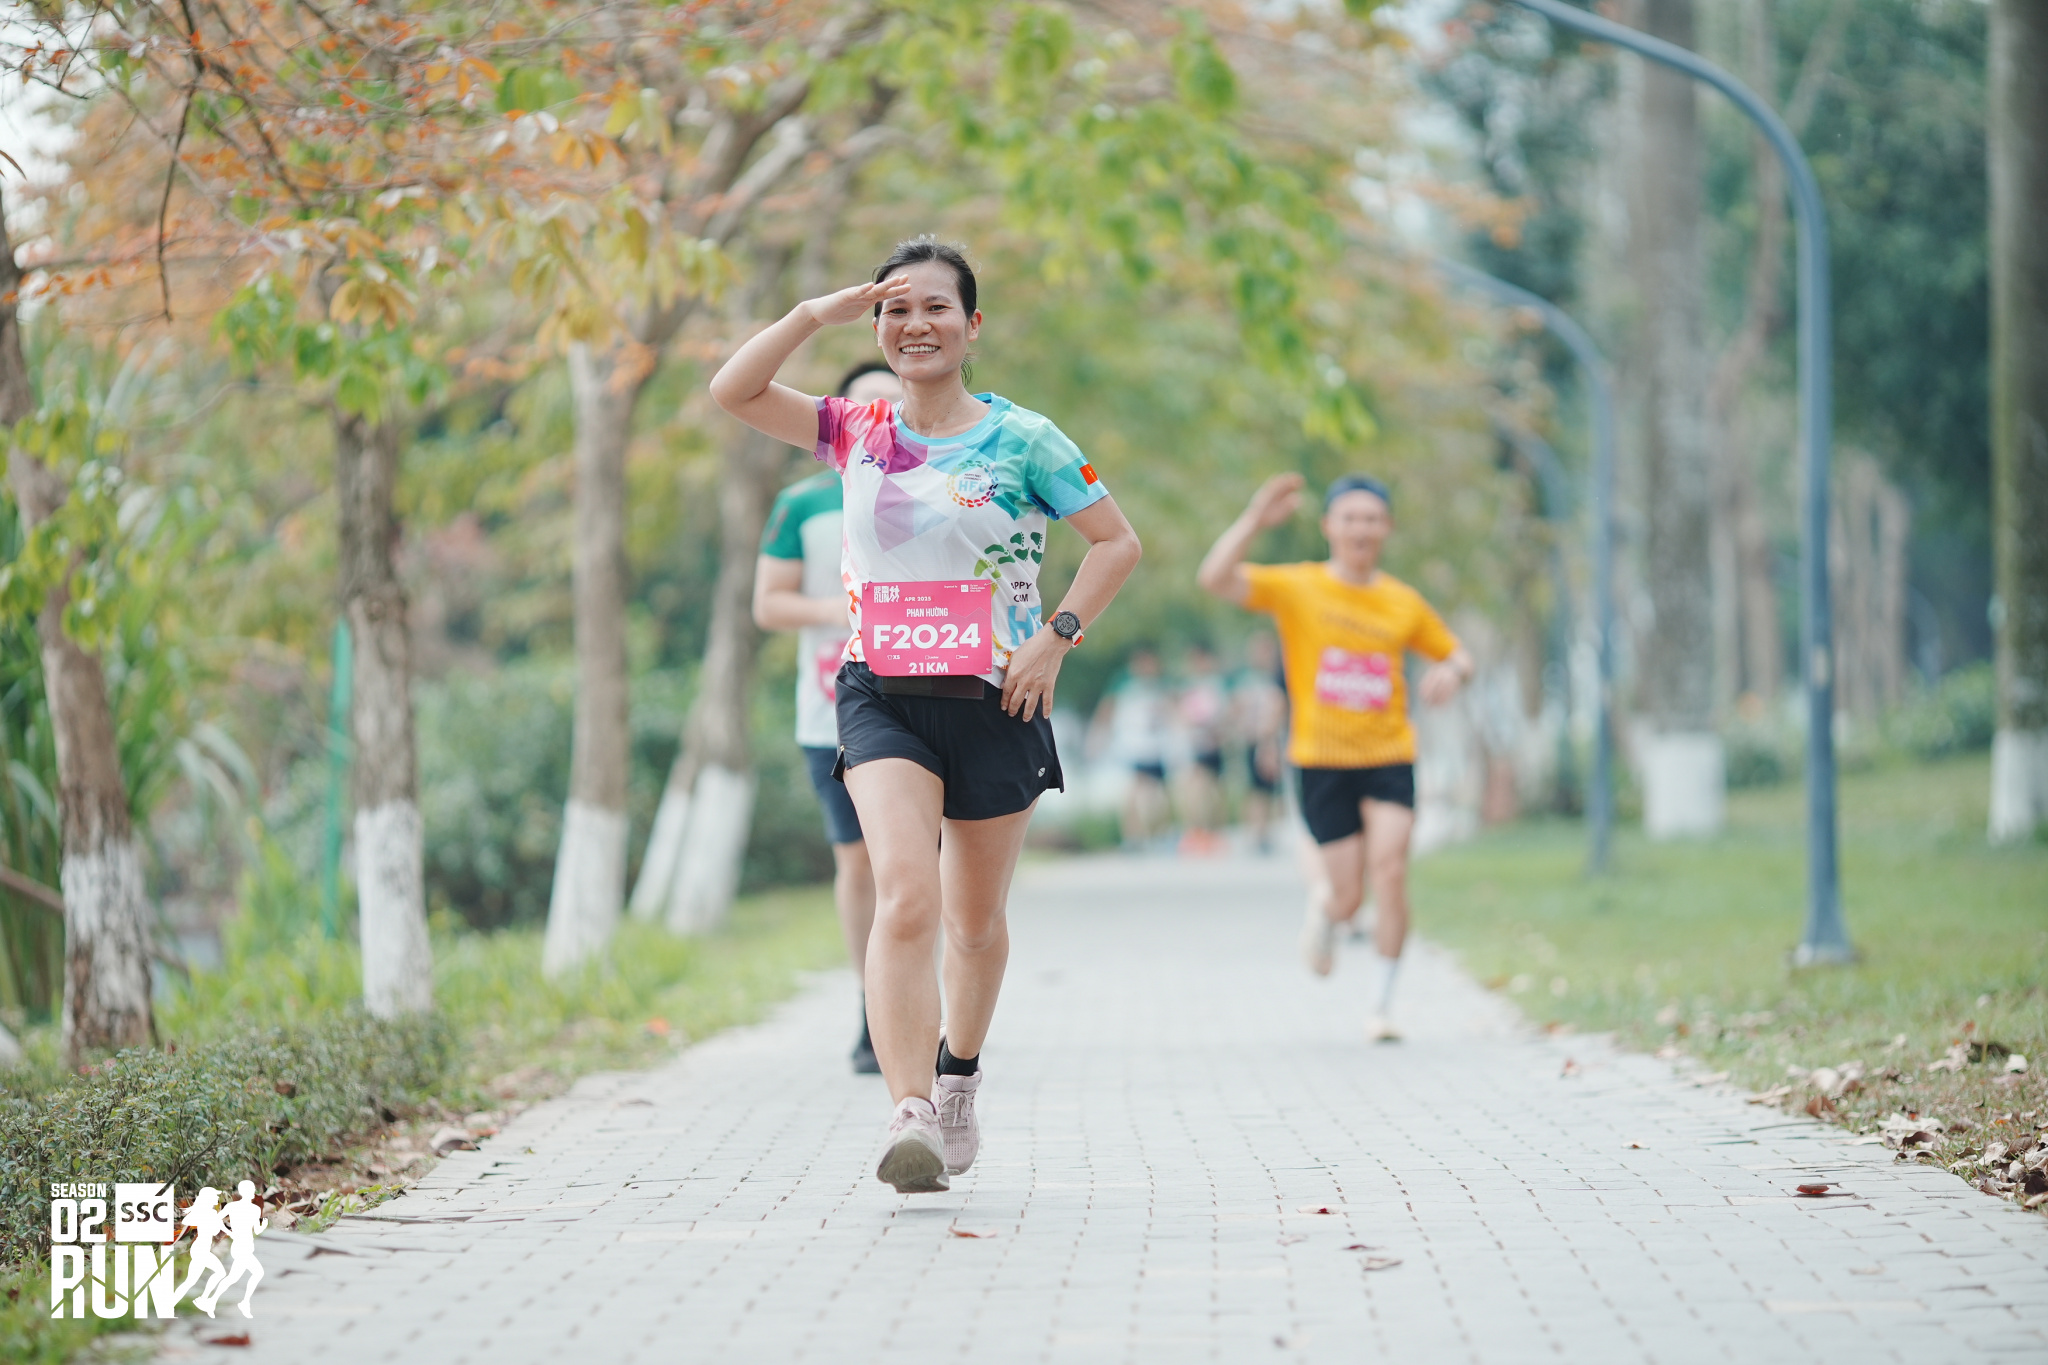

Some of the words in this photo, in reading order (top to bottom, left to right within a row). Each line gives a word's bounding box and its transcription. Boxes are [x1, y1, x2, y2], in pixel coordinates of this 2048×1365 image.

[958, 480, 986, 492] HFC
[873, 593, 890, 603] RUN
[906, 608, 925, 618] PHAN
[873, 623, 981, 650] F2024
[908, 661, 949, 674] 21KM
